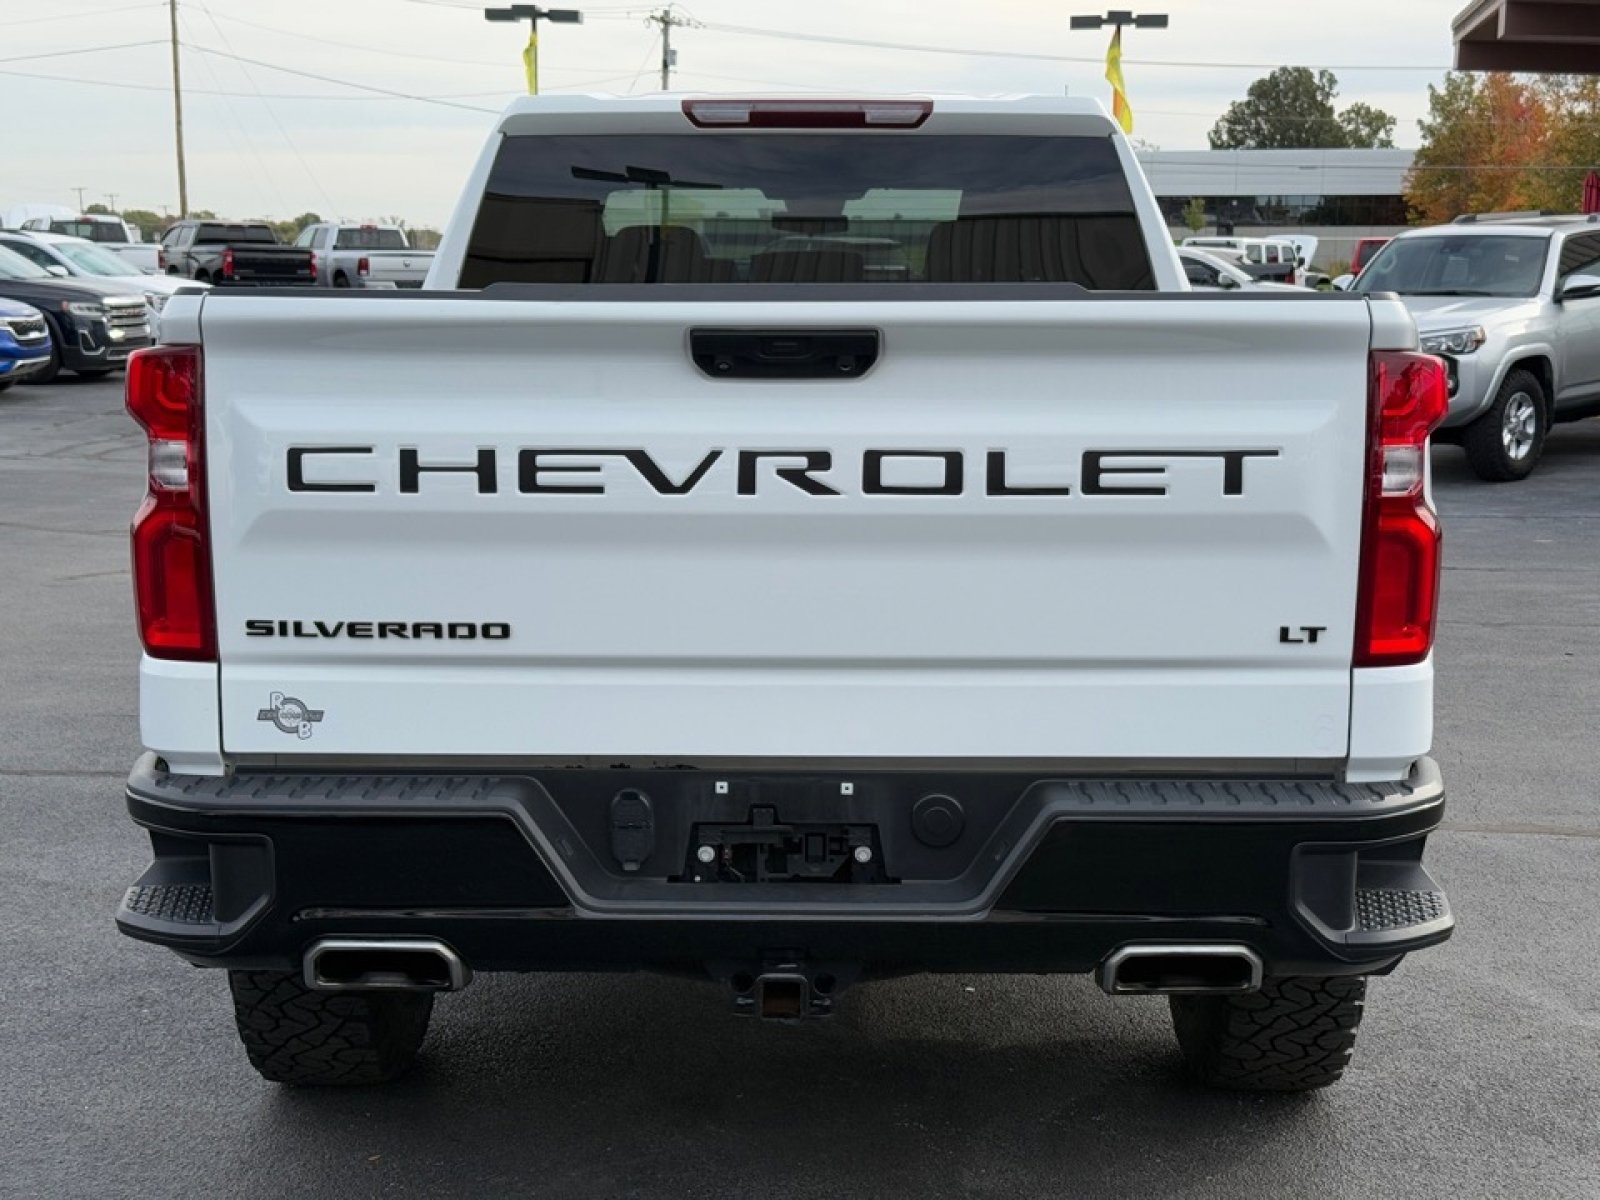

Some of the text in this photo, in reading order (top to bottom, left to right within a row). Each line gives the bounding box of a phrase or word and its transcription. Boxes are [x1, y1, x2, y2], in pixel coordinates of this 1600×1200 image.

[286, 446, 1280, 496] CHEVROLET
[245, 619, 511, 640] SILVERADO
[1279, 626, 1328, 643] LT
